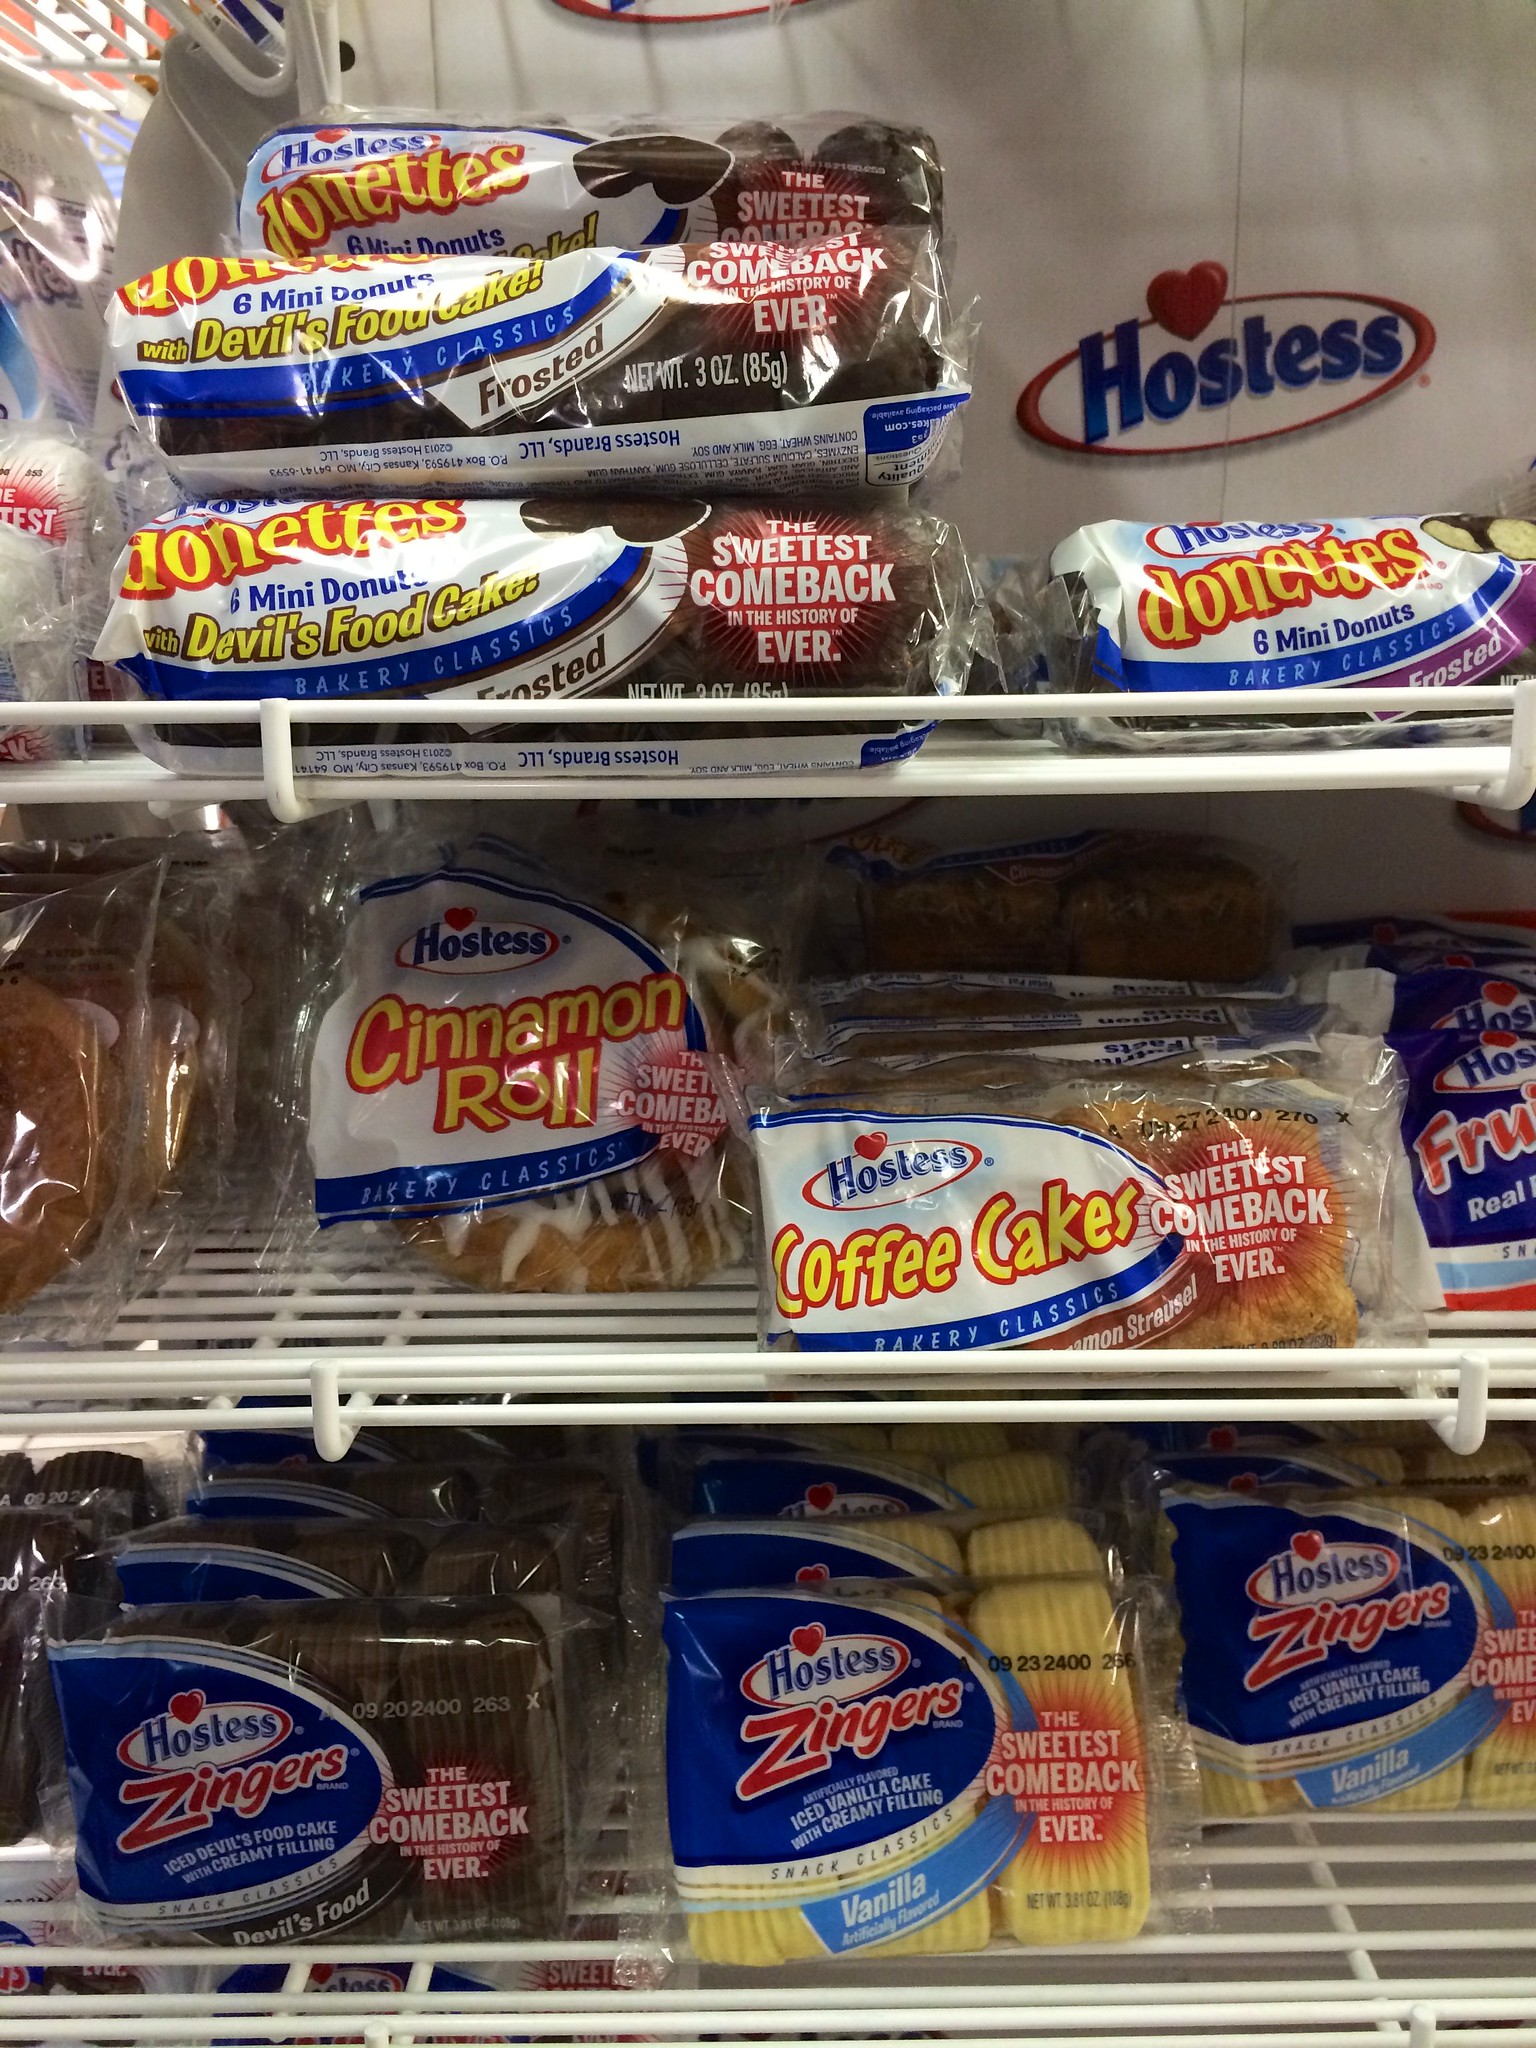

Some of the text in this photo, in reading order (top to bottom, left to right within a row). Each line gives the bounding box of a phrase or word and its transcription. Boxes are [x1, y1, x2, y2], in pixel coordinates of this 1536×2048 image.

[283, 131, 428, 168] Hostess
[782, 171, 825, 188] THE
[262, 144, 528, 258] donettes
[737, 191, 870, 222] SWEETEST
[347, 235, 364, 254] 6
[416, 229, 506, 253] Donuts
[688, 247, 888, 288] COMEBACK
[771, 276, 830, 293] HISTORY
[834, 276, 852, 290] OF
[233, 294, 252, 315] 6
[261, 286, 323, 312] Mini
[332, 273, 436, 303] Donuts
[753, 295, 837, 333] EVER.
[142, 340, 188, 361] with
[197, 313, 328, 360] Devil's
[302, 307, 574, 392] BAKERY CLASSICS
[480, 324, 605, 415] Frosted
[694, 359, 707, 385] 3
[710, 357, 740, 386] OZ.
[743, 352, 788, 389] (85g)
[1079, 314, 1404, 446] Hostess
[421, 457, 464, 471] 419593,
[465, 456, 487, 469] Box
[487, 455, 508, 467] P.O.
[519, 429, 681, 460] Hostess Brands, LLC
[691, 430, 858, 457] CONTAINS WHEAT, EGG, MILK AND SOY.
[337, 464, 357, 475] MO
[357, 461, 382, 475] City,
[382, 460, 420, 473] Kansas
[121, 501, 461, 591] donettes
[766, 520, 817, 534] THE
[1171, 522, 1323, 554] Hostess
[713, 533, 872, 567] SWEETEST
[249, 580, 315, 613] Mini
[691, 562, 896, 607] COMEBACK
[1143, 528, 1425, 643] donettes
[190, 603, 422, 660] Devil's Food
[728, 608, 858, 626] IN THE HISTORY OF
[1253, 601, 1416, 655] 6 Mini Donuts
[296, 605, 574, 695] BAKERY CLASSICS
[757, 630, 842, 664] EVER.
[1229, 615, 1457, 685] BAKERY CLASSICS
[1408, 627, 1502, 687] Frosted
[518, 748, 680, 768] Hostess Brands, LLC
[412, 923, 548, 965] Hostess
[350, 977, 681, 1088] Cinnamon
[443, 1048, 596, 1130] Roll
[1276, 1109, 1319, 1125] 270
[1207, 1138, 1254, 1162] THE
[361, 1143, 620, 1205] BAKERY CLASSICS
[826, 1144, 968, 1207] Hostess
[1165, 1155, 1307, 1202] SWEETEST
[1151, 1188, 1334, 1237] COMEBACK
[1467, 1179, 1525, 1222] Real
[774, 1183, 1139, 1314] Coffee Cakes
[1186, 1227, 1298, 1253] IN THE HISTORY OF
[1214, 1247, 1287, 1284] EVER.
[874, 1280, 1119, 1352] BAKERY CLASSICS
[1126, 1273, 1199, 1341] Streusel
[1268, 1553, 1390, 1602] Hostess
[1246, 1584, 1450, 1692] Zingers
[767, 1645, 896, 1701] Hostess
[988, 1655, 1013, 1672] 09
[352, 1702, 378, 1720] 09
[472, 1695, 511, 1714] 263
[1288, 1665, 1421, 1713] ICED VANILLA CAKE
[1288, 1679, 1431, 1729] WITH CREAMY FILLING
[140, 1711, 279, 1764] Hostess
[738, 1680, 961, 1799] Zingers
[1039, 1710, 1081, 1728] THE
[1001, 1729, 1122, 1761] SWEETEST
[427, 1766, 467, 1783] THE
[985, 1759, 1142, 1797] COMEBACK
[1331, 1748, 1410, 1794] Vanilla
[118, 1746, 348, 1852] Zingers
[384, 1780, 511, 1813] SWEETEST
[790, 1772, 933, 1831] ICED VANILLA CAKE
[1015, 1796, 1114, 1813] IN THE HISTORY OF
[368, 1805, 530, 1845] COMEBACK
[790, 1787, 944, 1851] WITH CREAMY FILLING
[1038, 1814, 1104, 1844] EVER.
[164, 1820, 338, 1877] ICED DEVIL'S FOOD CAKE
[182, 1836, 336, 1884] WITH CREAMY FILLING
[400, 1839, 501, 1857] IN THE HISTORY OF
[770, 1807, 955, 1881] SNACK CLASSICS
[158, 1857, 339, 1916] SNACK CLASSICS
[423, 1857, 490, 1881] EVER.
[232, 1877, 372, 1947] Devil's Food
[840, 1871, 927, 1928] Vanilla
